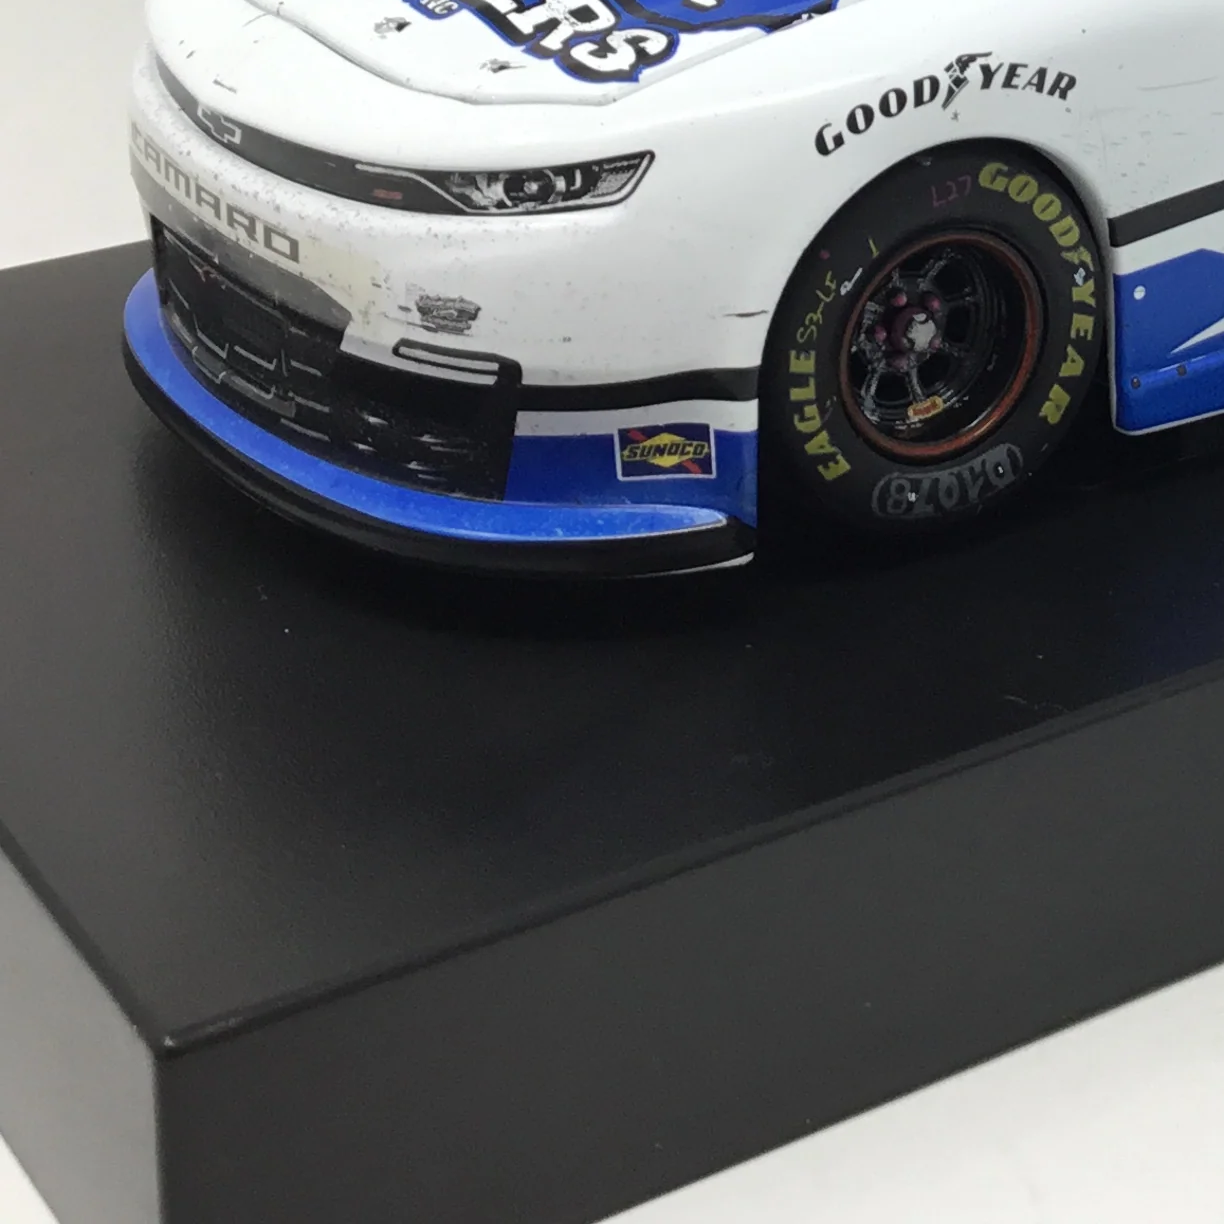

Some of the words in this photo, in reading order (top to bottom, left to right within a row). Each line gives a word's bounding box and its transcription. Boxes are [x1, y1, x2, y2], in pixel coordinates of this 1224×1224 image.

[813, 58, 1077, 157] GOODYEAR
[130, 121, 300, 264] CAMARO
[977, 162, 1097, 426] GOODYEAR
[625, 442, 707, 460] SUNOCO
[788, 348, 852, 482] EAGLE
